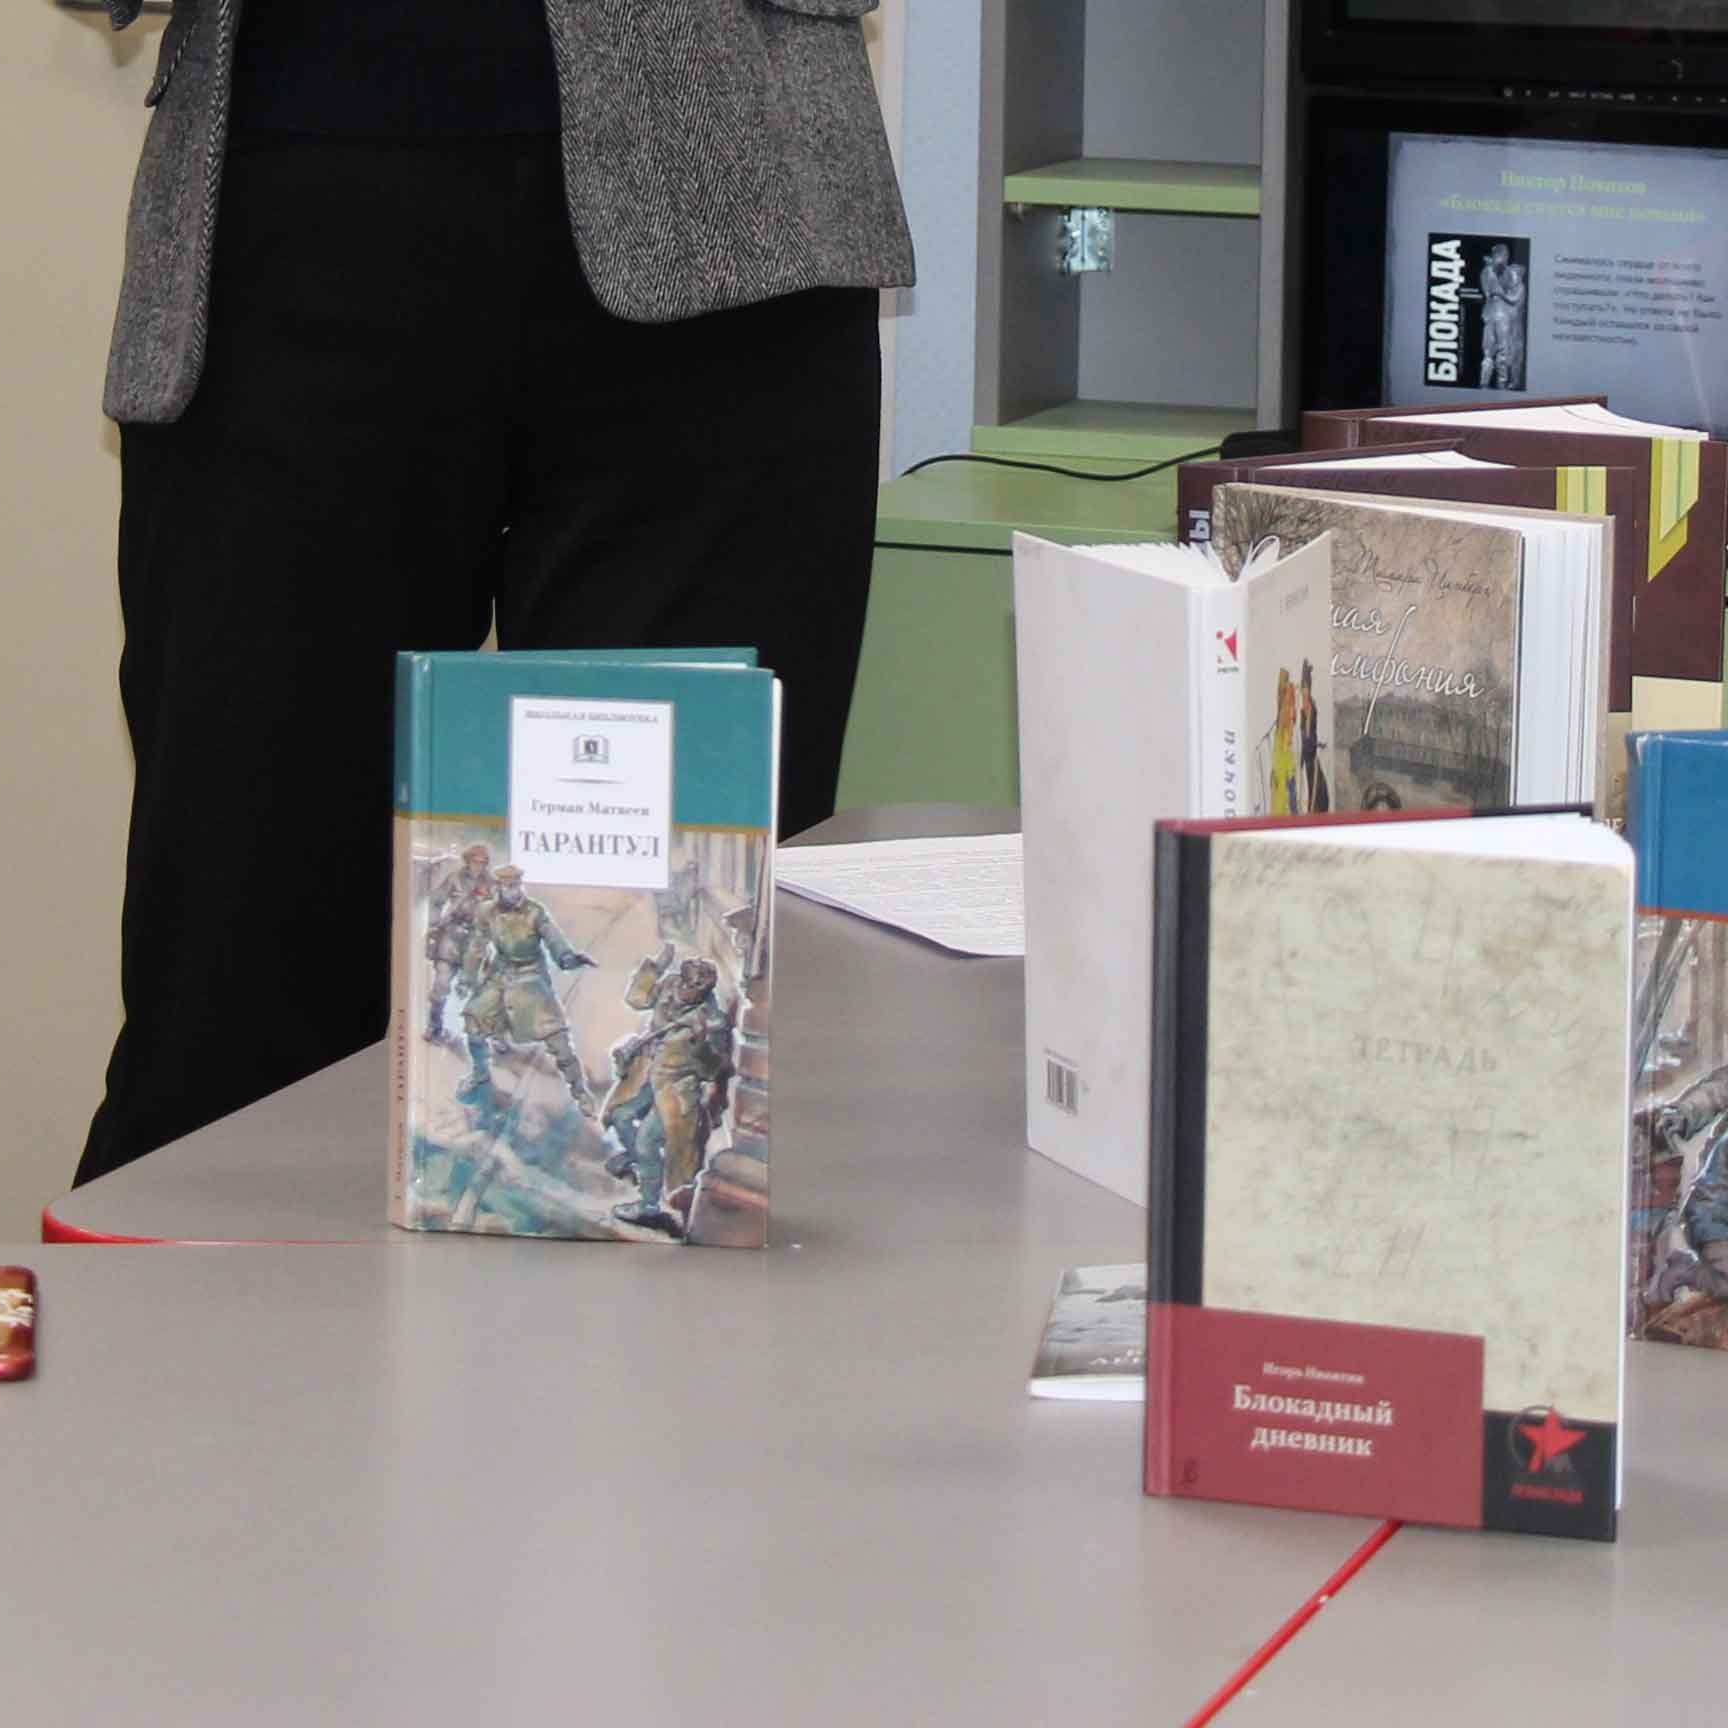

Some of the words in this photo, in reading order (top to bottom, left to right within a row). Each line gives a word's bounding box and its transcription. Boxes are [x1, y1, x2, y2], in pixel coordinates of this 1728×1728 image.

[530, 798, 584, 815] Герман
[588, 801, 650, 817] Матвеев
[518, 830, 660, 857] ТАРАНТУЛ
[1233, 1383, 1393, 1426] Блокадный
[1250, 1427, 1373, 1457] дневник
